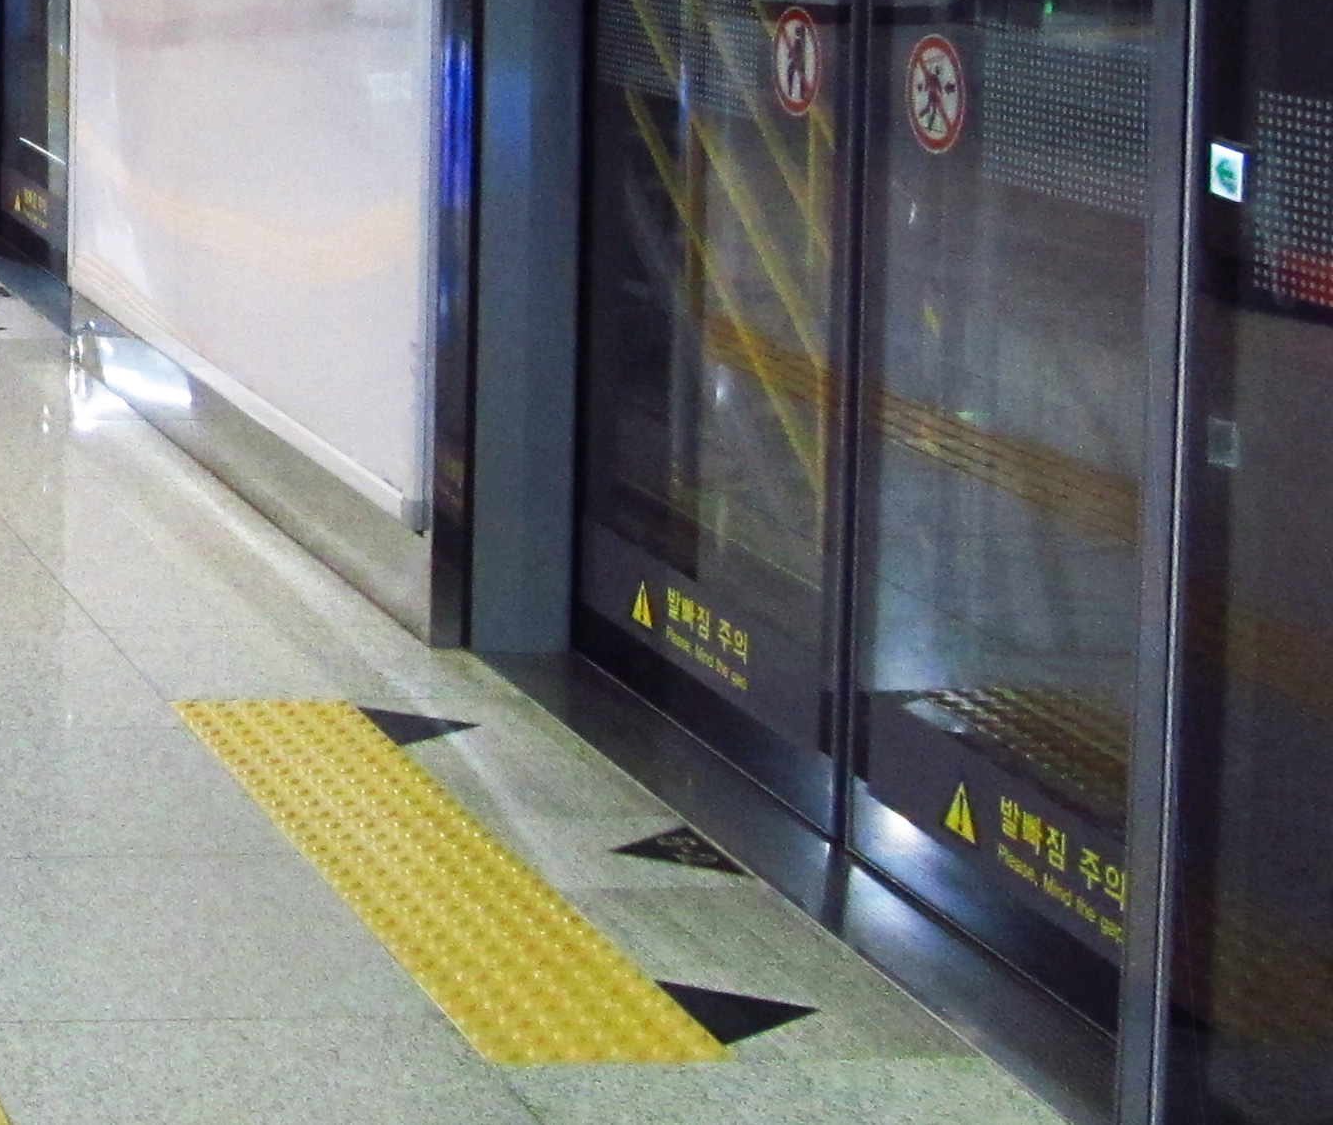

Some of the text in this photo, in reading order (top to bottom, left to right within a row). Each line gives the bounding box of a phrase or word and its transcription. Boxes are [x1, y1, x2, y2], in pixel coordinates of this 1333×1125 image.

[667, 586, 748, 666] 발빠짐 주의
[1000, 795, 1126, 911] 발빠짐 주의
[1075, 895, 1098, 923] the
